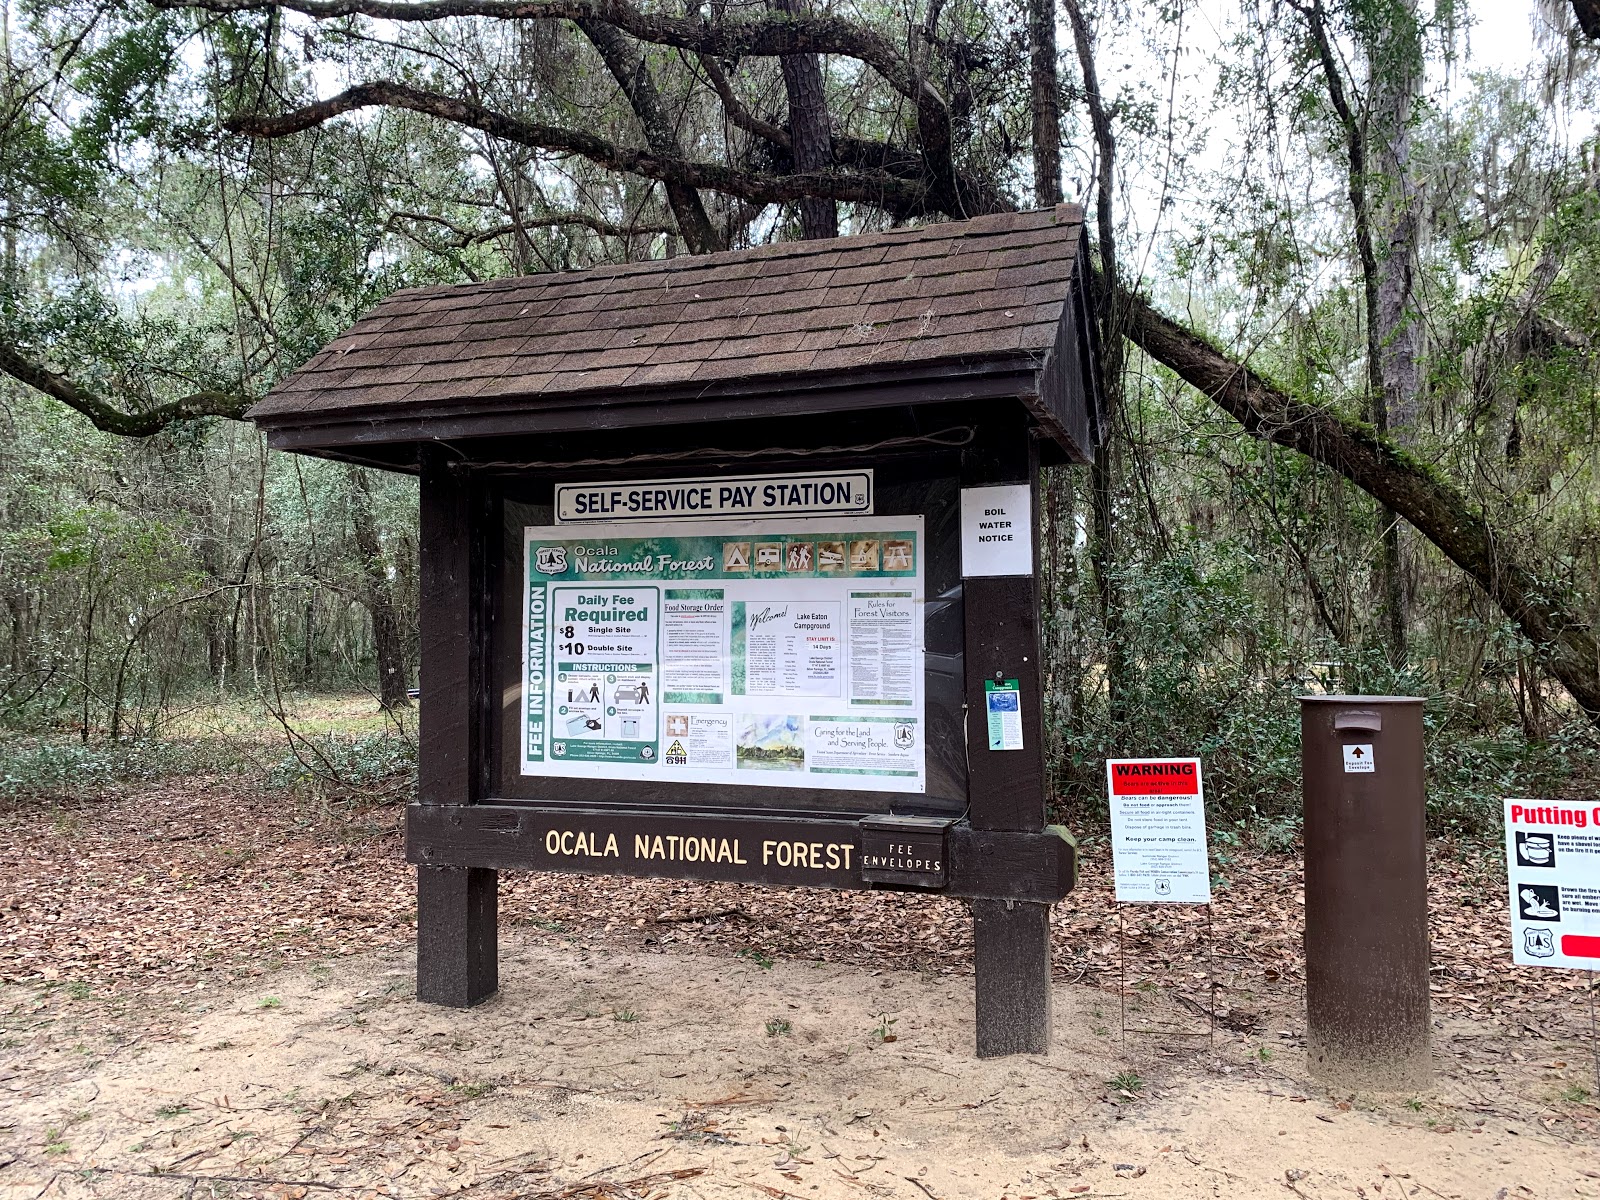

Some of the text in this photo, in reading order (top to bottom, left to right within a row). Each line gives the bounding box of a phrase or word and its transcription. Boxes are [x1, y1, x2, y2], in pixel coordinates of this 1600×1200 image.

[575, 481, 851, 514] SELF-SERVICE PAY STATION
[979, 521, 1012, 529] WATER
[978, 534, 1013, 542] NOTICE
[574, 546, 618, 556] Ocala
[574, 555, 653, 574] National
[656, 554, 714, 571] Forest
[577, 595, 635, 607] Daily Fee
[867, 600, 896, 609] Rules for
[664, 603, 723, 612] Food Storage Order
[854, 607, 910, 618] Forest Visitors
[564, 607, 648, 624] Required
[793, 622, 831, 631] Campground
[528, 586, 545, 755] FEE INFORMATION
[572, 664, 638, 672] INSTRUCTIONS
[690, 716, 728, 728] Emergency
[814, 727, 835, 738] Caring
[856, 728, 871, 738] Land
[827, 737, 839, 746] and
[840, 738, 866, 749] Serving
[1116, 764, 1193, 776] WARNING
[1511, 805, 1587, 828] Putting
[546, 830, 855, 870] OCALA NATIONAL FOREST
[889, 844, 914, 855] FEE
[863, 855, 941, 871] ENVELOPES
